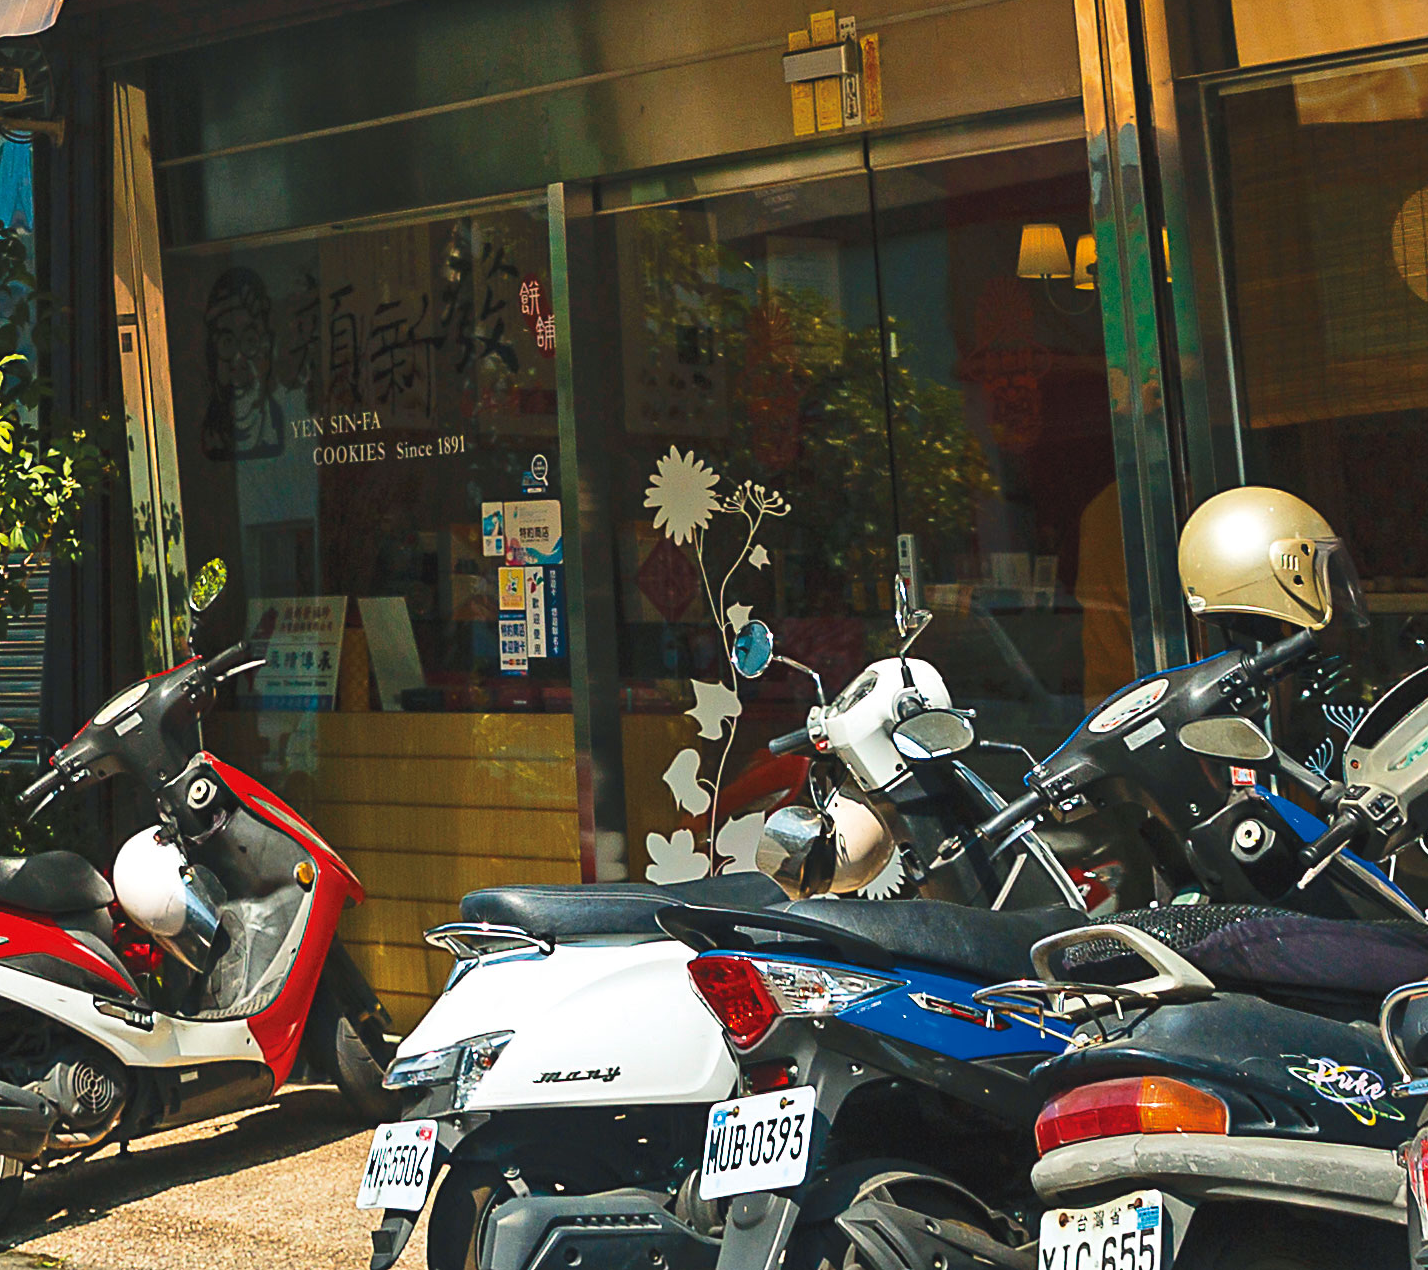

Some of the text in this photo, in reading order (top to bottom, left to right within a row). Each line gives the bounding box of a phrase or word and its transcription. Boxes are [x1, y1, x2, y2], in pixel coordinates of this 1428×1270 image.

[290, 411, 382, 440] YEN SIN-FA
[313, 434, 466, 466] COOKIES Since 1891
[532, 1064, 622, 1084] many
[1307, 1057, 1387, 1101] Duke
